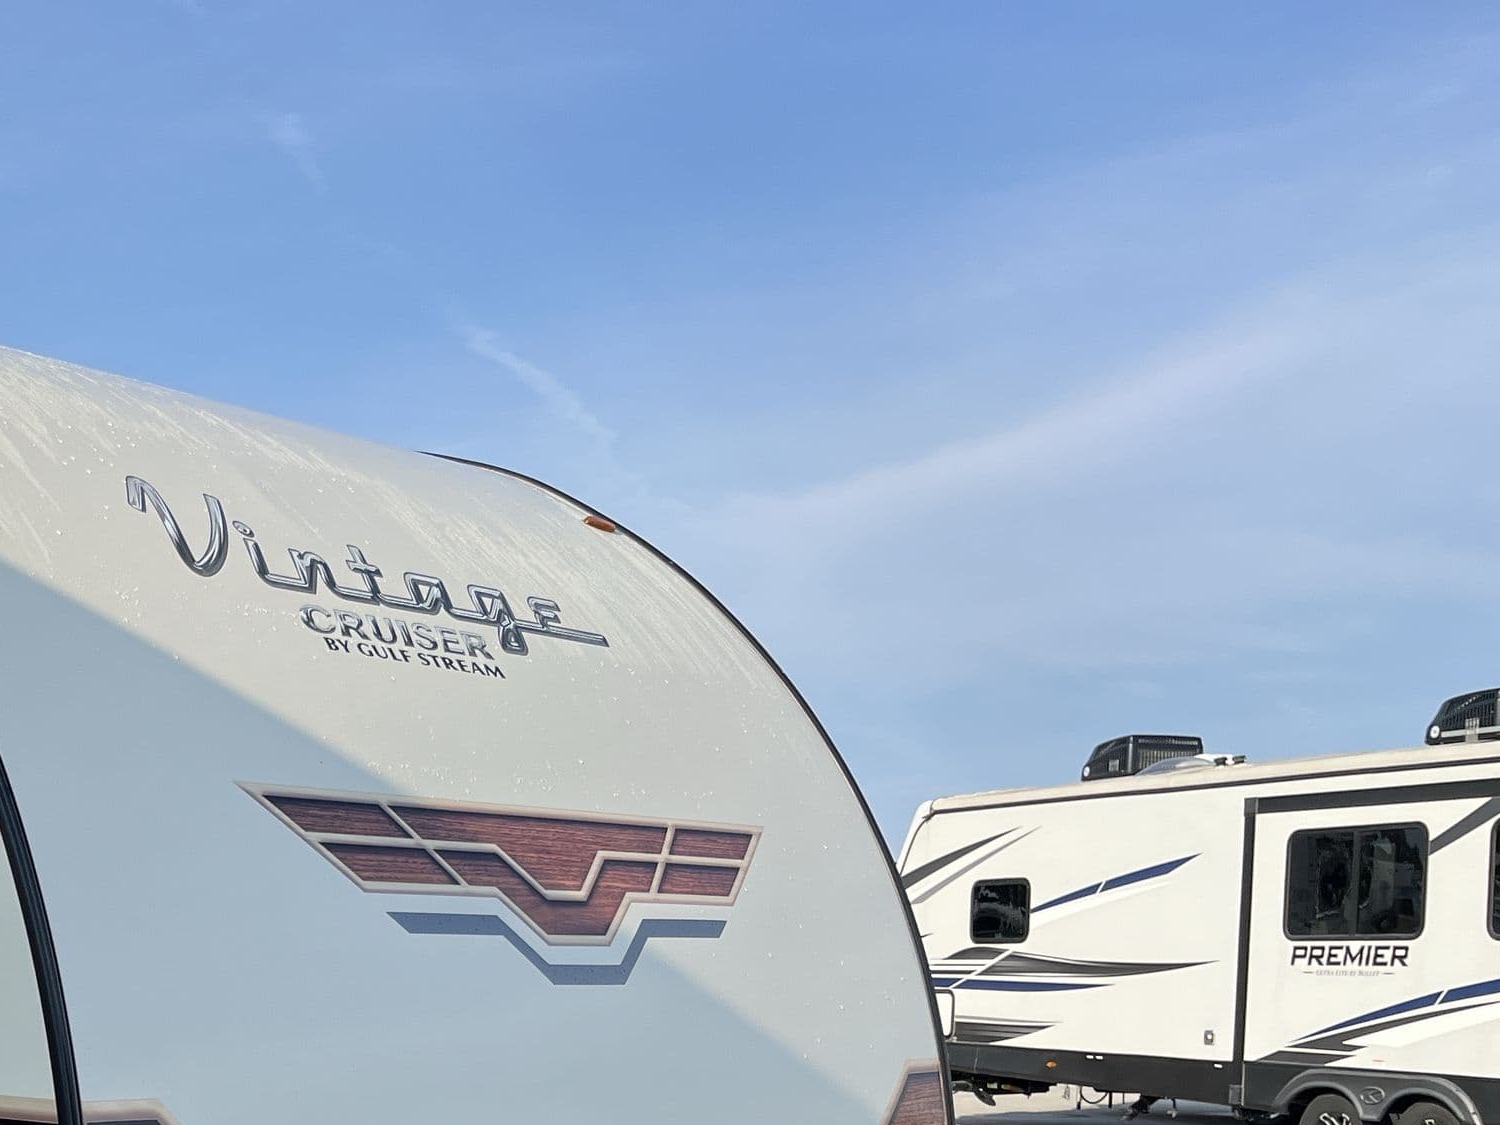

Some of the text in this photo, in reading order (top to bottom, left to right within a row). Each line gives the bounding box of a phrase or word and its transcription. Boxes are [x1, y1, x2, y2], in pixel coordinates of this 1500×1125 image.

[126, 475, 609, 655] Vintage
[300, 604, 495, 660] CRUISER
[323, 637, 506, 679] BY GULF STREAM
[1290, 945, 1409, 967] PREMIER
